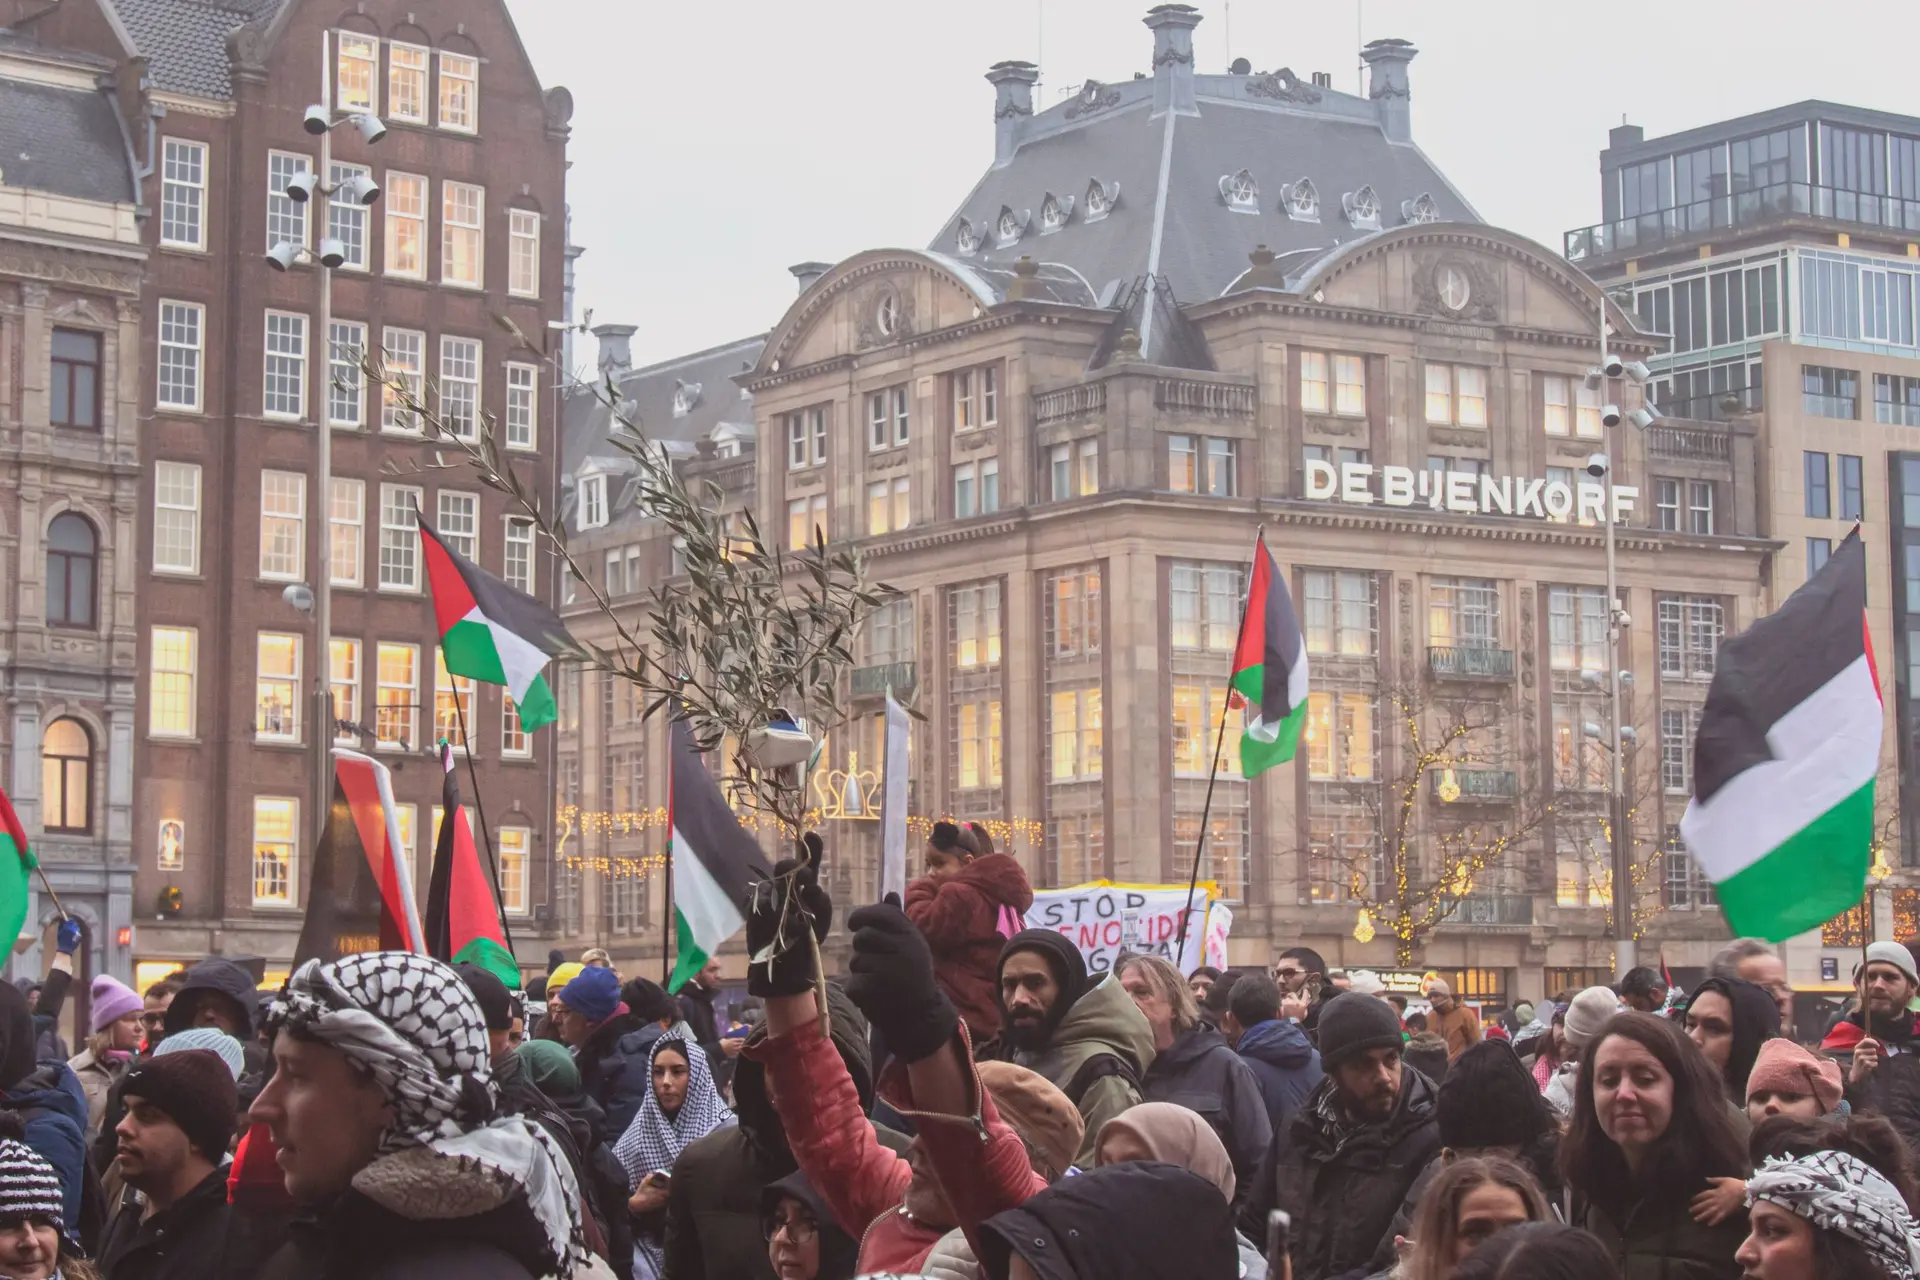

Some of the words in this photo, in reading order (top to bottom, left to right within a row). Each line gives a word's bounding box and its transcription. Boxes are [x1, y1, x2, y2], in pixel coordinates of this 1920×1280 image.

[1304, 459, 1374, 504] DE
[1383, 464, 1640, 523] BIJENKORF
[1044, 893, 1146, 927] STOP
